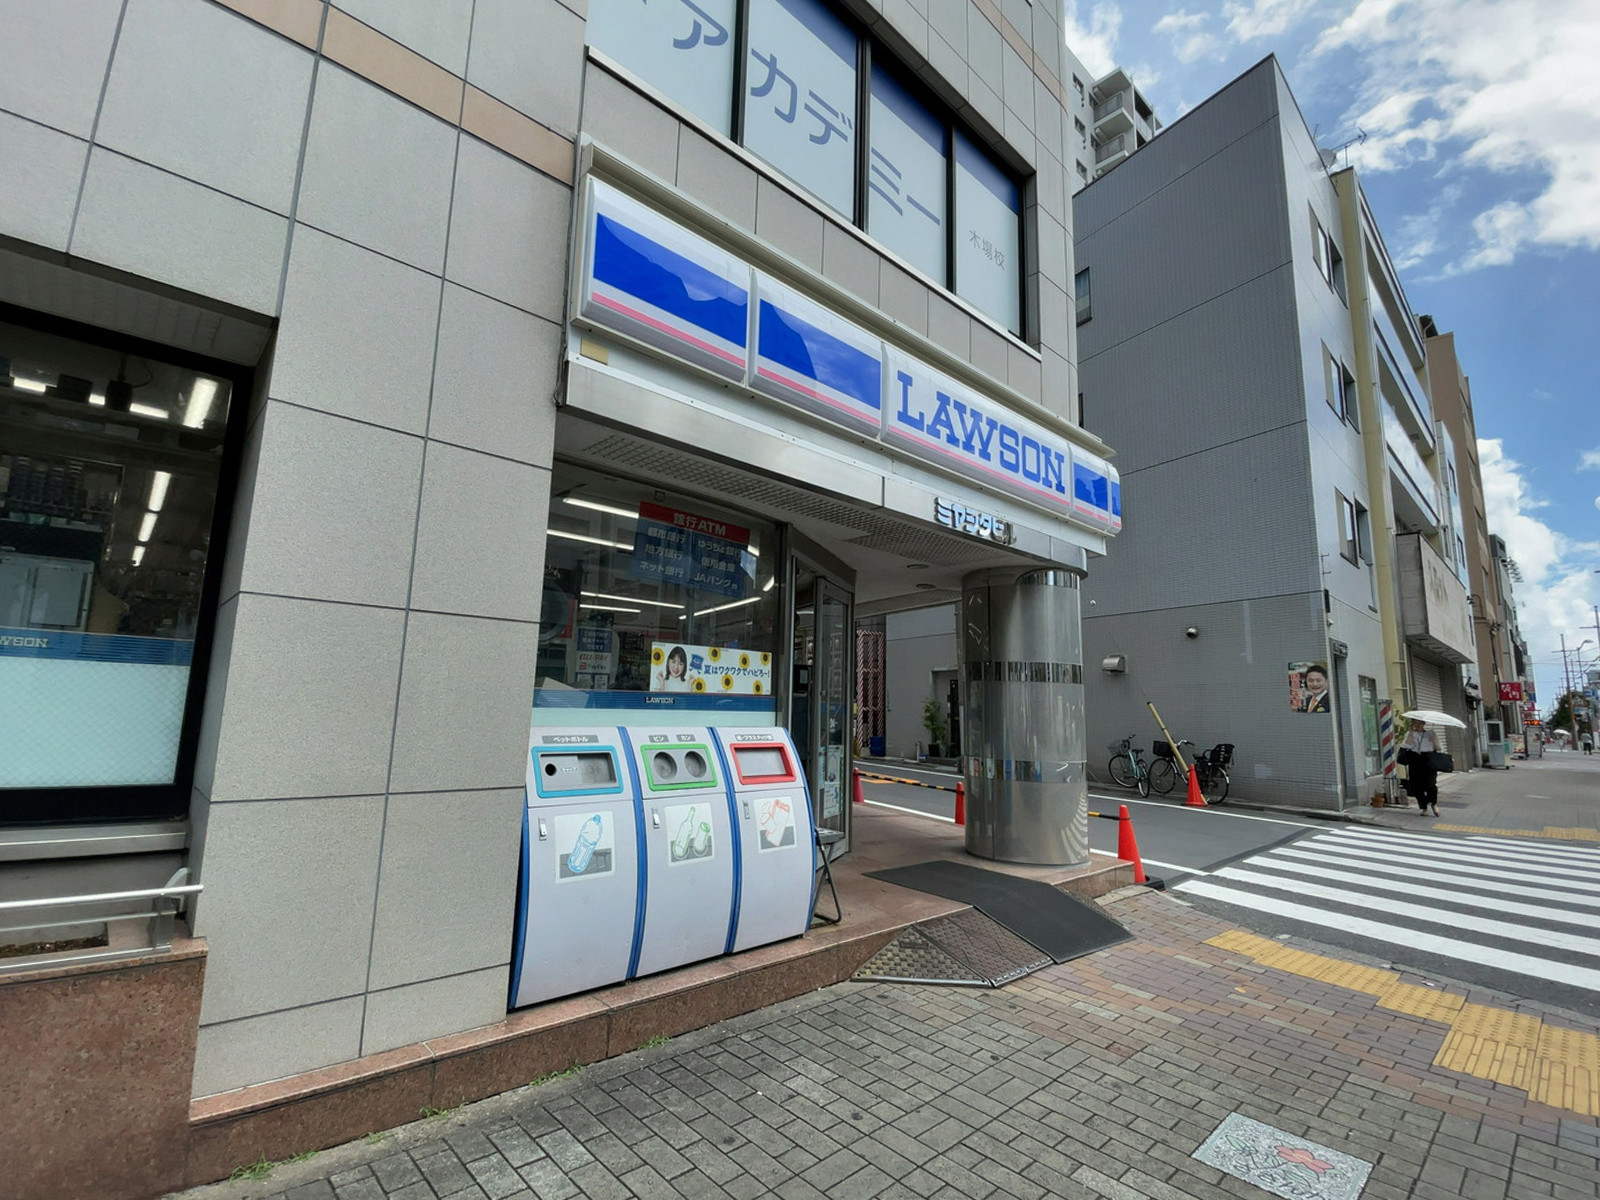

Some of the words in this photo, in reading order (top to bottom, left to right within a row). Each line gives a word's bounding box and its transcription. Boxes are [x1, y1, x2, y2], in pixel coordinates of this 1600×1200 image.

[968, 229, 1006, 271] 木場校
[896, 369, 1066, 495] LAWSON
[645, 697, 674, 705] LAWSON
